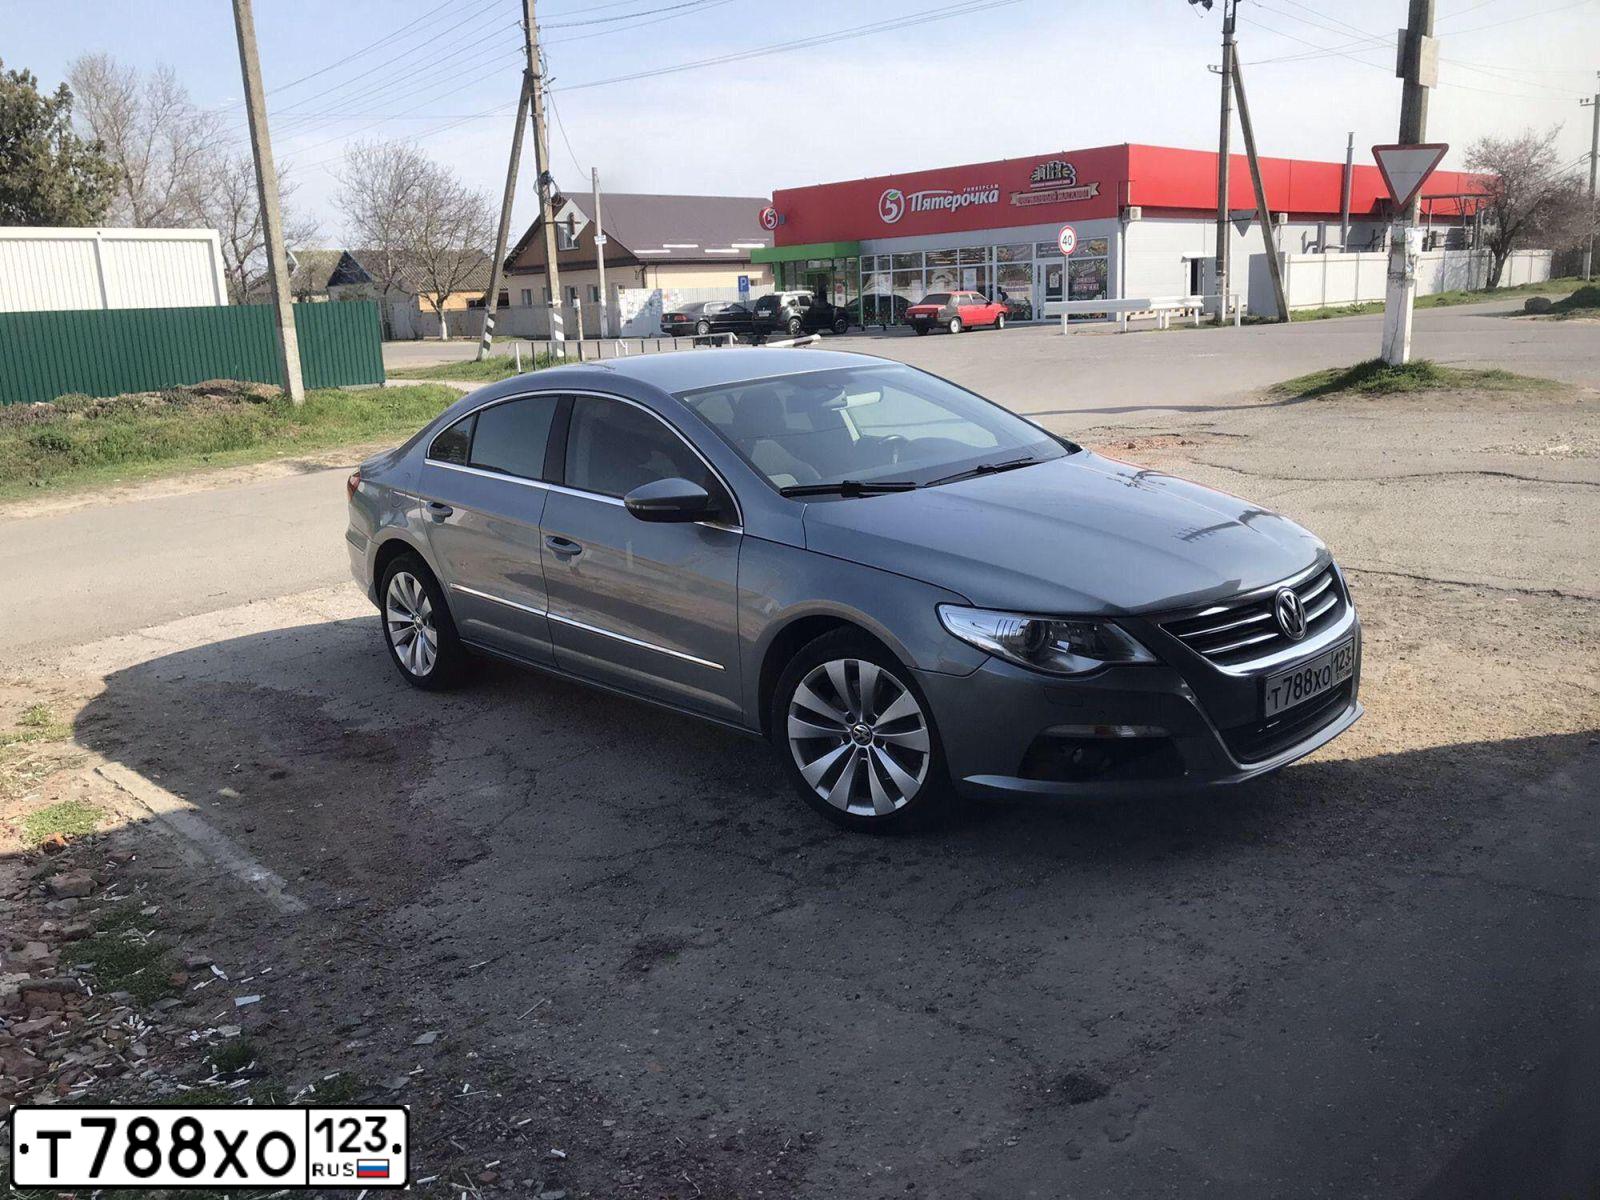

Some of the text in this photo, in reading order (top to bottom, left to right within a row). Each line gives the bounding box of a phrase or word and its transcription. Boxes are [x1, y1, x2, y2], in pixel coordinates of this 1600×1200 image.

[1062, 235, 1073, 246] 40
[740, 277, 748, 292] P
[1271, 645, 1352, 709] Т788ХО 123
